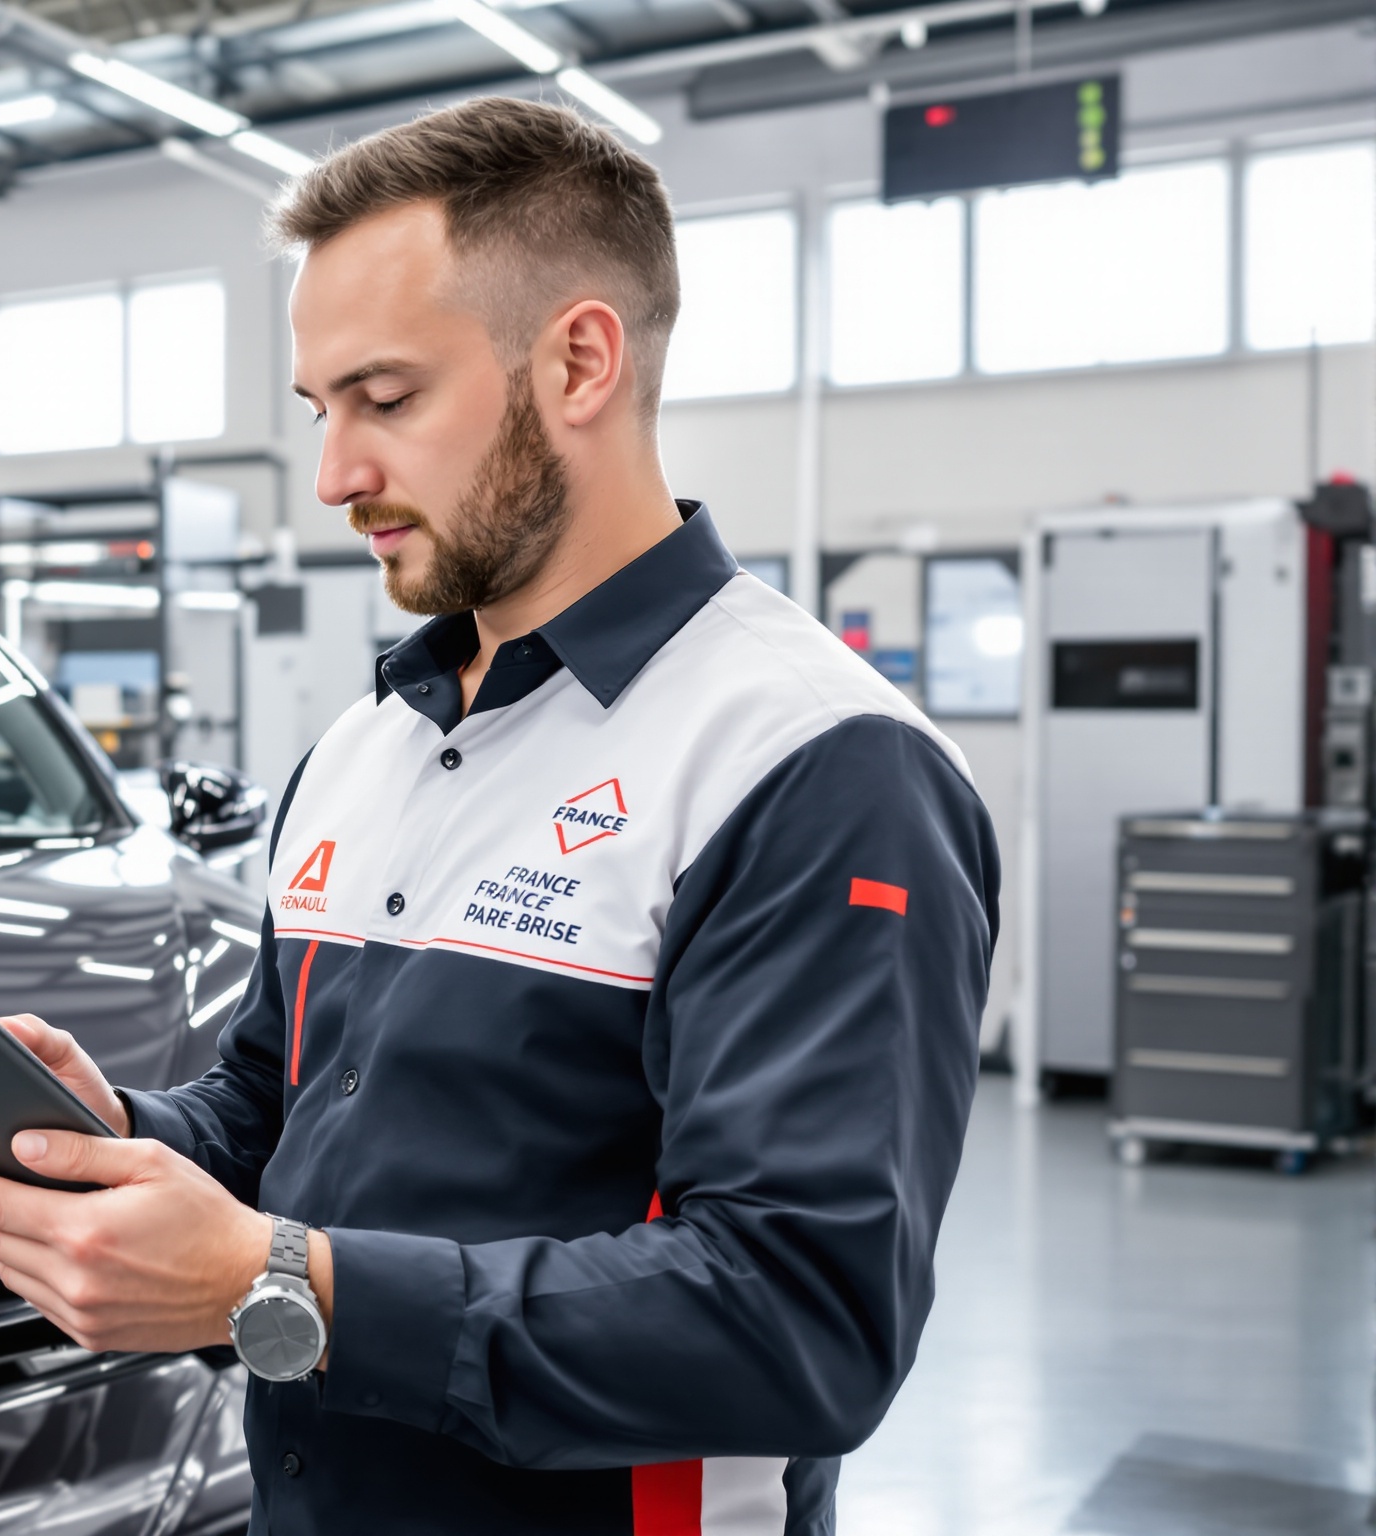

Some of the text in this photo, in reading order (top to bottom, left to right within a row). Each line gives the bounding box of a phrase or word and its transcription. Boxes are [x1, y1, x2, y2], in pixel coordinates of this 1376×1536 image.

[552, 806, 628, 832] FRANCE
[474, 880, 554, 911] FRANCE
[504, 866, 581, 897] FRANCE
[464, 903, 582, 944] PARE-BRISE
